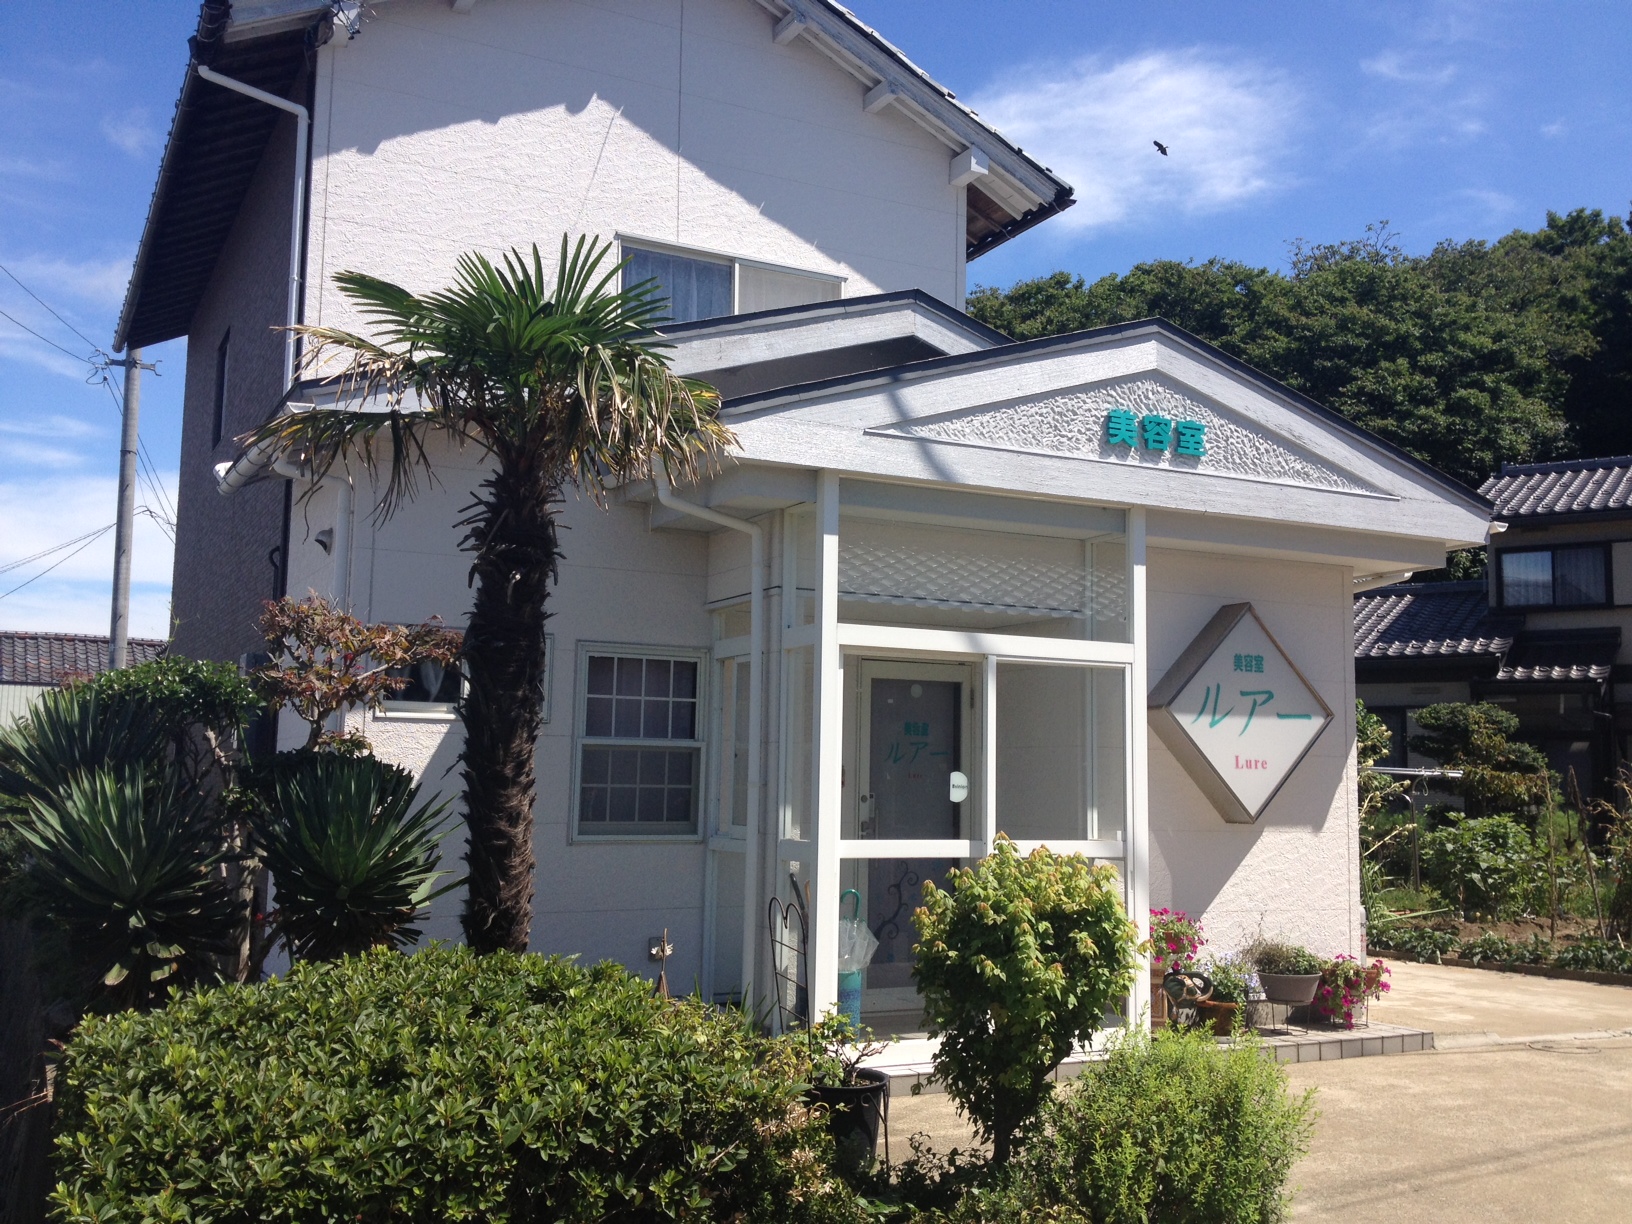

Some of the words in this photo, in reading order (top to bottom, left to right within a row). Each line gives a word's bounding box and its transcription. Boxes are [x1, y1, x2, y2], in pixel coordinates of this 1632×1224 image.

[1107, 408, 1207, 457] 美容室
[1233, 653, 1265, 674] 美容室
[1191, 682, 1312, 737] ルアー
[883, 741, 950, 764] ルアー
[1234, 755, 1268, 770] Lure
